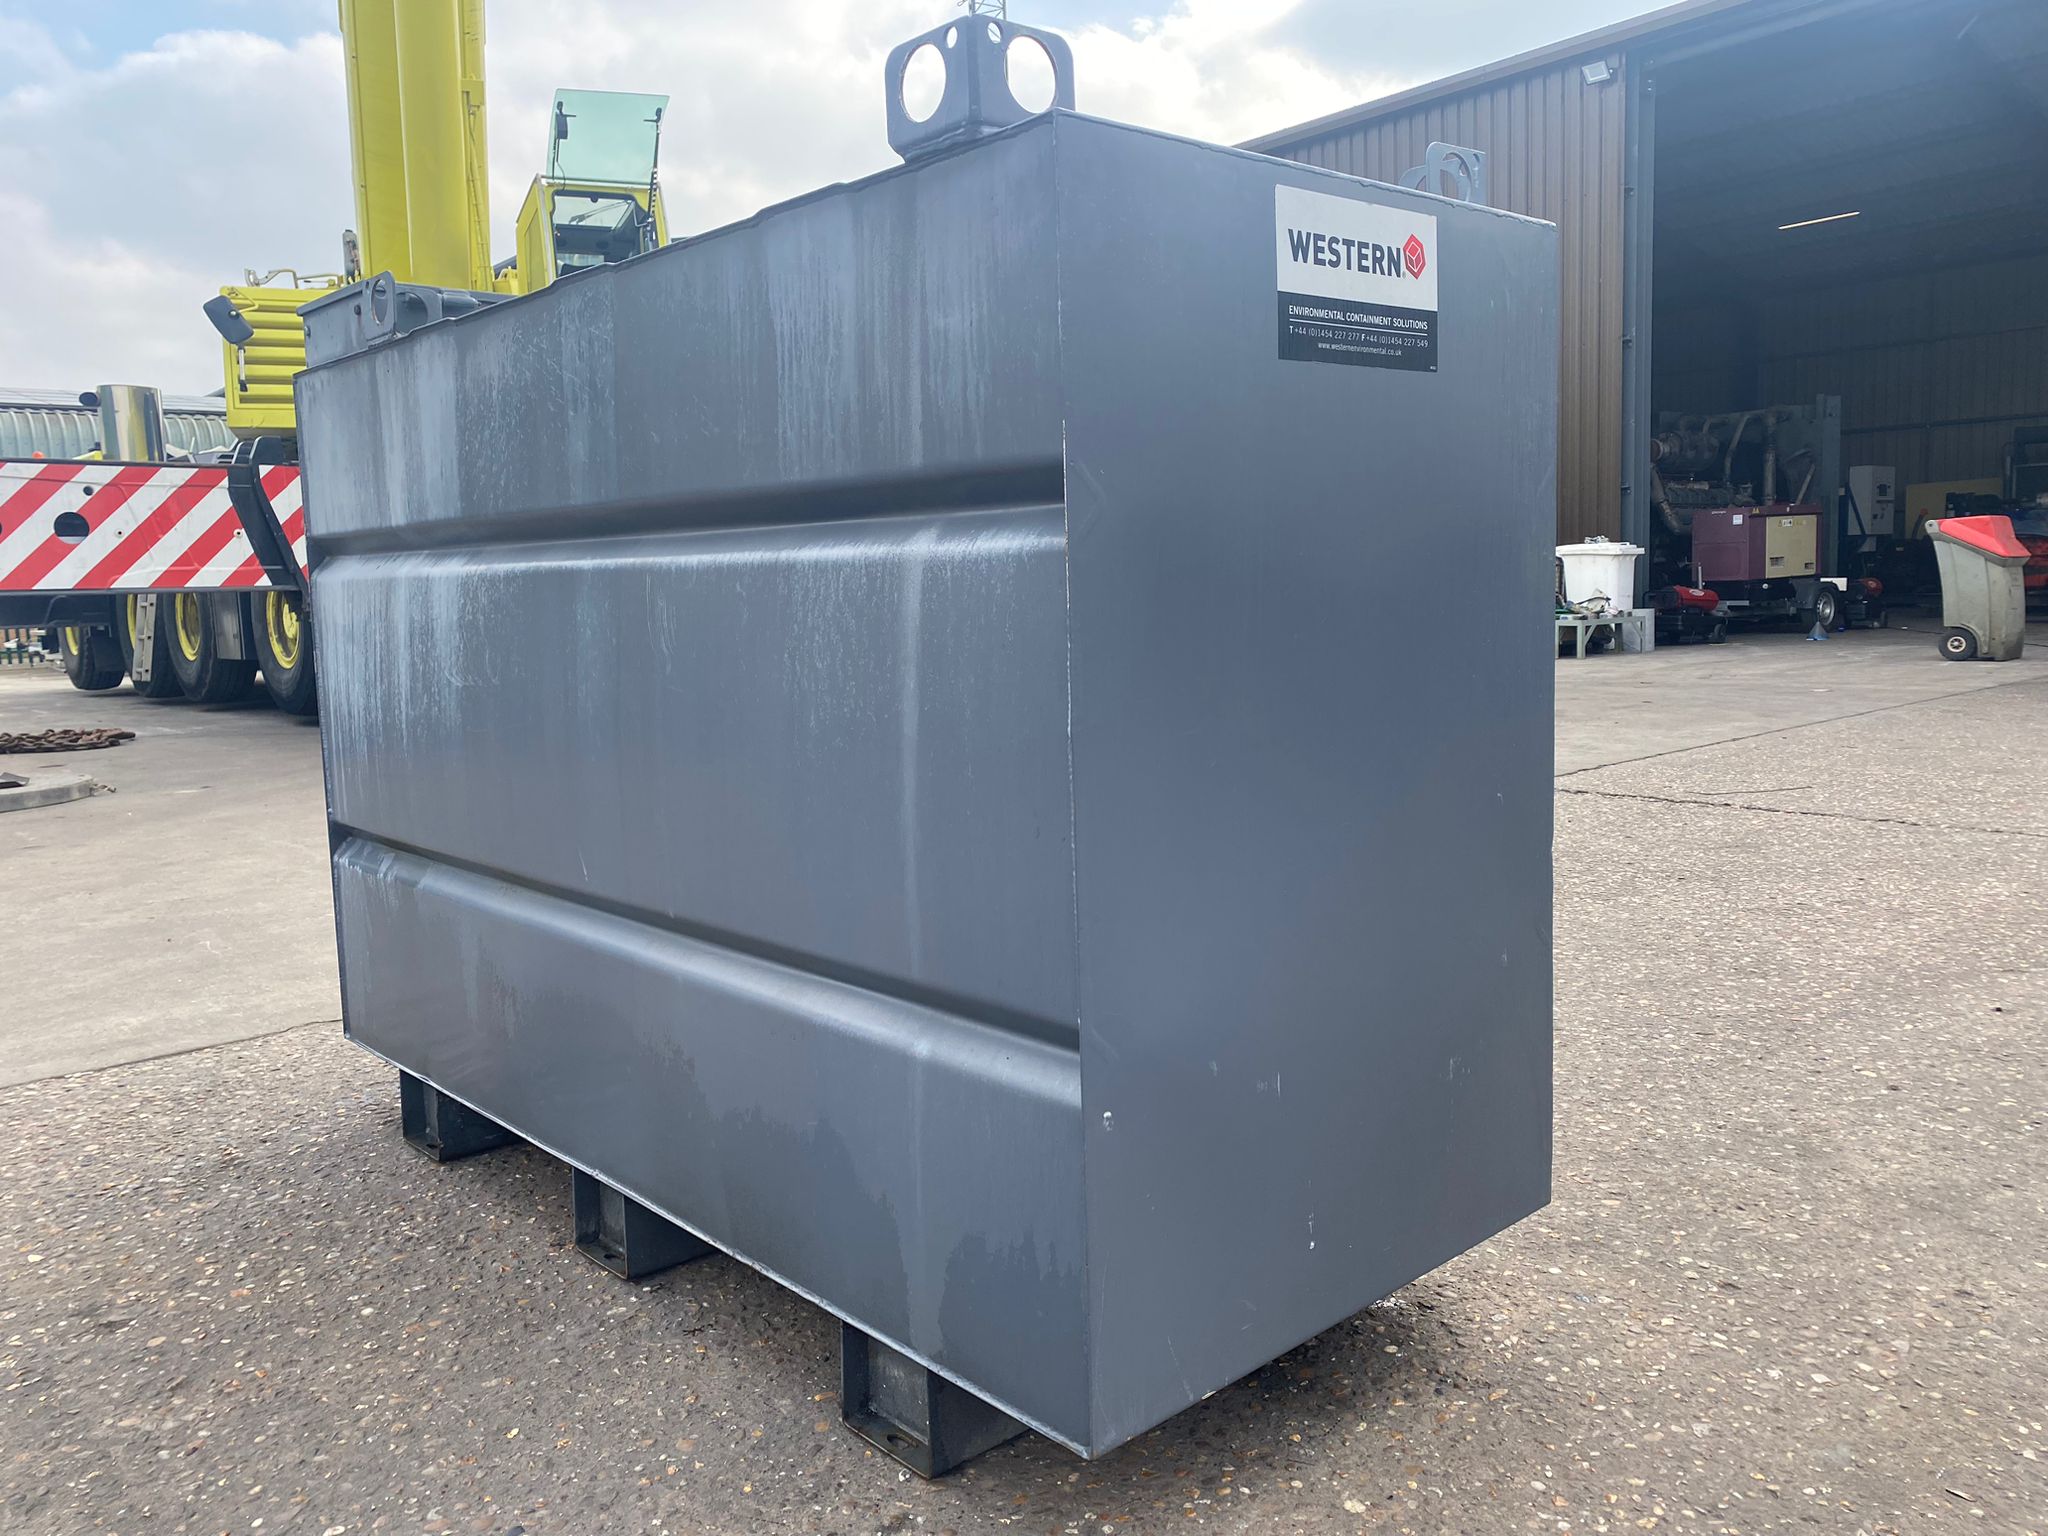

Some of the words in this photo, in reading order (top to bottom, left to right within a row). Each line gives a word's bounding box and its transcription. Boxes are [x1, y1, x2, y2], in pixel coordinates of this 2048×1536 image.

[1288, 228, 1401, 278] WESTERN
[1289, 305, 1345, 321] ENVIRONMENTAL
[1346, 312, 1392, 326] CONTAINMENT
[1393, 317, 1428, 330] SOLUTIONS
[1308, 327, 1333, 338] (0)1454
[1334, 330, 1346, 339] 227
[1348, 331, 1360, 341] 277
[1379, 335, 1402, 345] (0)1454
[1404, 338, 1415, 346] 227
[1417, 339, 1429, 348] 549
[1318, 342, 1402, 356] www.westernenvironmental.co.uk
